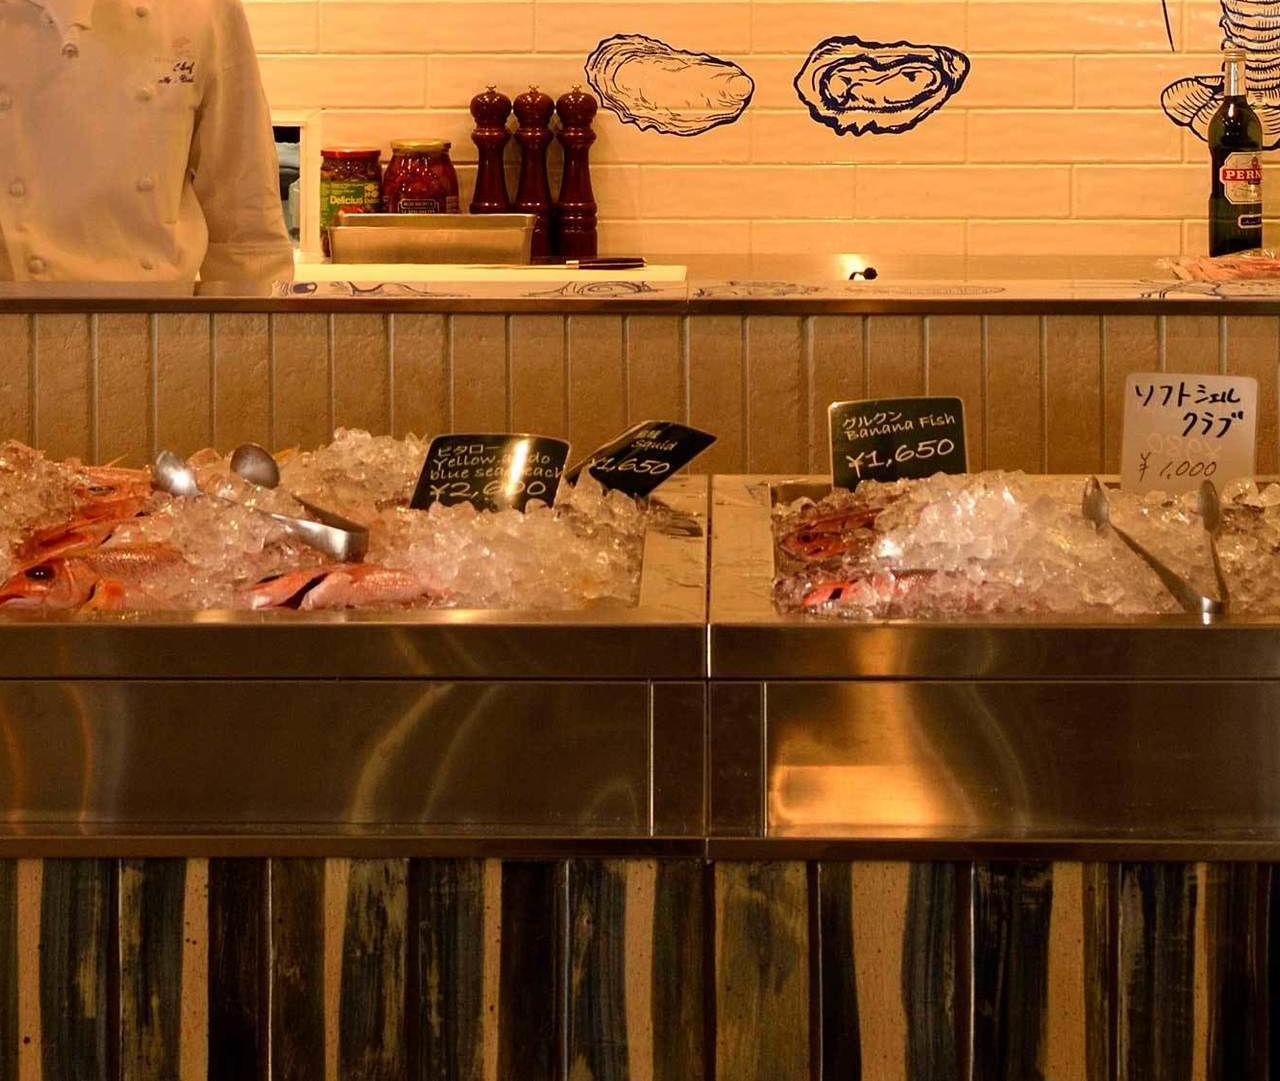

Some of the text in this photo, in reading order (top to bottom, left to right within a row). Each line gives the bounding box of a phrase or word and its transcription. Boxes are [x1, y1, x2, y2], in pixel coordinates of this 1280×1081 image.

[1135, 382, 1240, 407] ソフトシェル
[843, 420, 914, 441] Banana
[1182, 411, 1244, 438] クラブ
[845, 438, 955, 478] ¥1,650
[429, 468, 469, 481] blue
